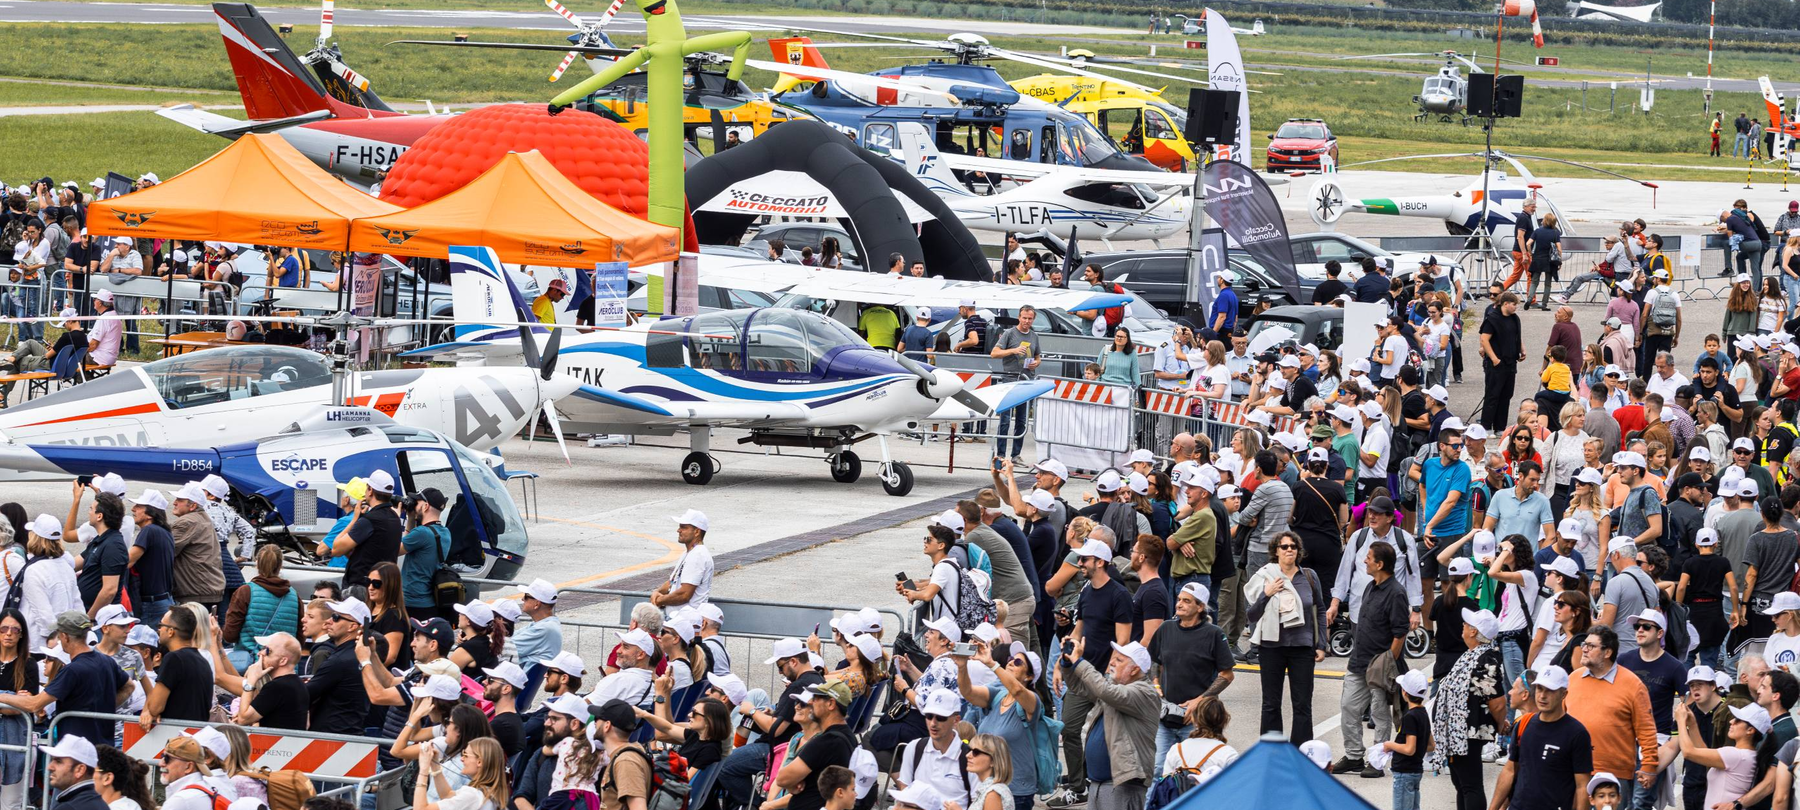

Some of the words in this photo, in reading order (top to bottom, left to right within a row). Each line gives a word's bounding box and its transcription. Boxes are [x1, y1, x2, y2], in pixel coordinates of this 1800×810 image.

[749, 193, 829, 207] CECCATO
[1400, 202, 1427, 210] I-BUCH
[727, 199, 827, 214] AUTOMOBILI
[995, 205, 1053, 225] I-TLFA
[598, 307, 623, 315] AEROCLUB
[403, 402, 427, 411] EXTRA
[454, 374, 526, 447] 41
[327, 411, 341, 421] LH
[173, 459, 213, 471] I-D854
[272, 458, 327, 471] ESCAPE
